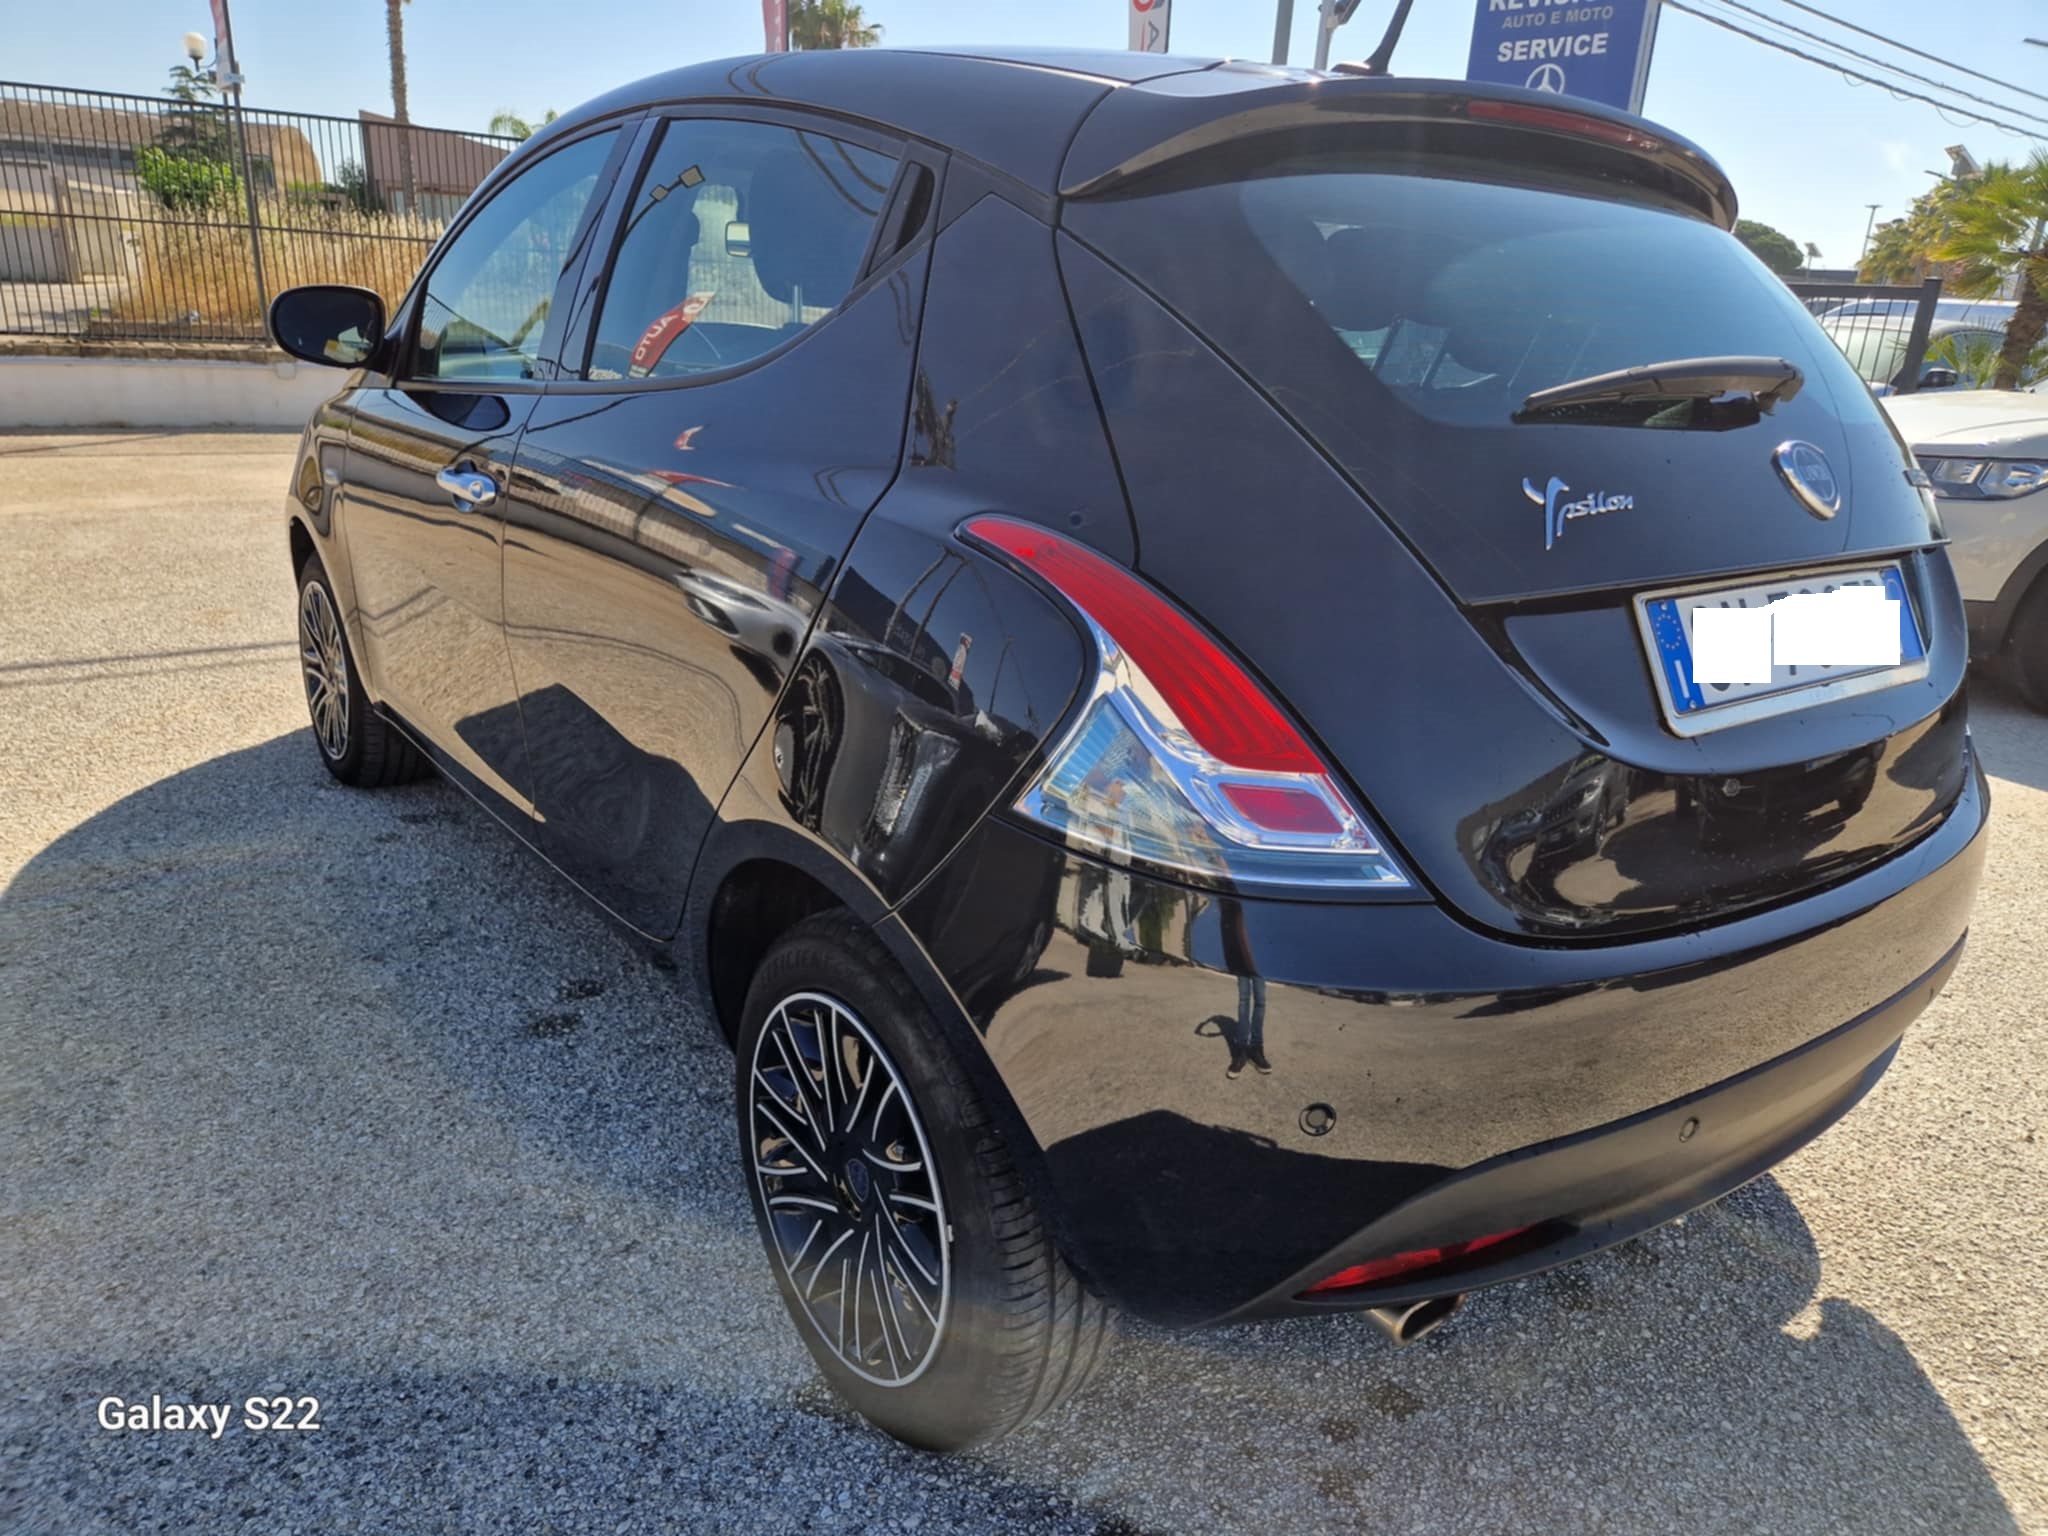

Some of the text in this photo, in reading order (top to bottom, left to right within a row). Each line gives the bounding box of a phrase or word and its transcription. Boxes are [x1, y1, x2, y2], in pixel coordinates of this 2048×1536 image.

[1502, 6, 1614, 29] AUTO E MOTO
[1497, 33, 1609, 62] SERVICE
[1521, 476, 1634, 550] Ypsilon
